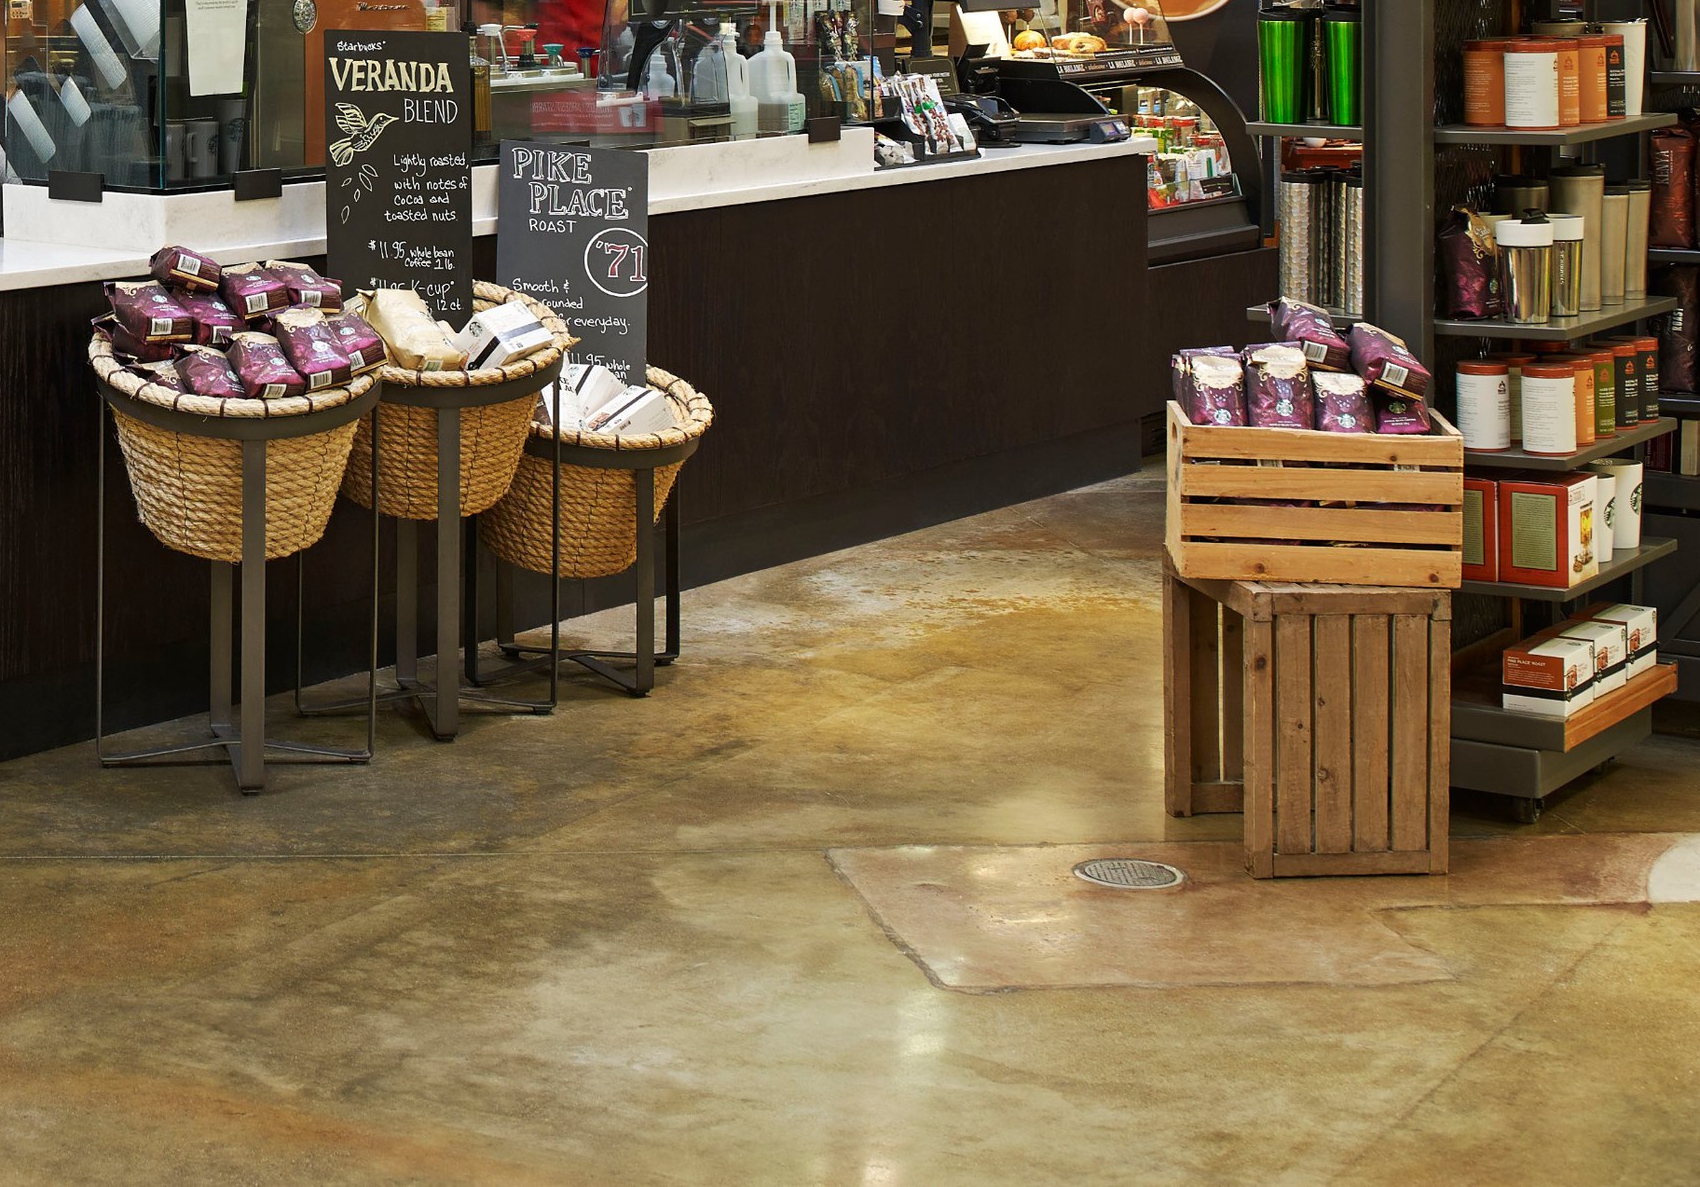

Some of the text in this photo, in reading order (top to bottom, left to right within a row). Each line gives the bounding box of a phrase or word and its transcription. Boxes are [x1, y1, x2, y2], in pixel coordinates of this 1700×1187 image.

[328, 57, 454, 93] VERANDA
[404, 98, 458, 124] BLEND
[393, 153, 427, 177] Lightly
[512, 147, 592, 184] PIKE
[1656, 150, 1670, 185] KENYA
[394, 176, 469, 190] with notes of
[429, 192, 450, 204] and
[529, 181, 629, 220] PLACE
[384, 208, 427, 222] toasted
[530, 218, 577, 233] ROAST
[410, 246, 432, 259] whole
[433, 245, 455, 258] bean
[512, 278, 559, 293] Smooth
[574, 316, 630, 335] everyday.
